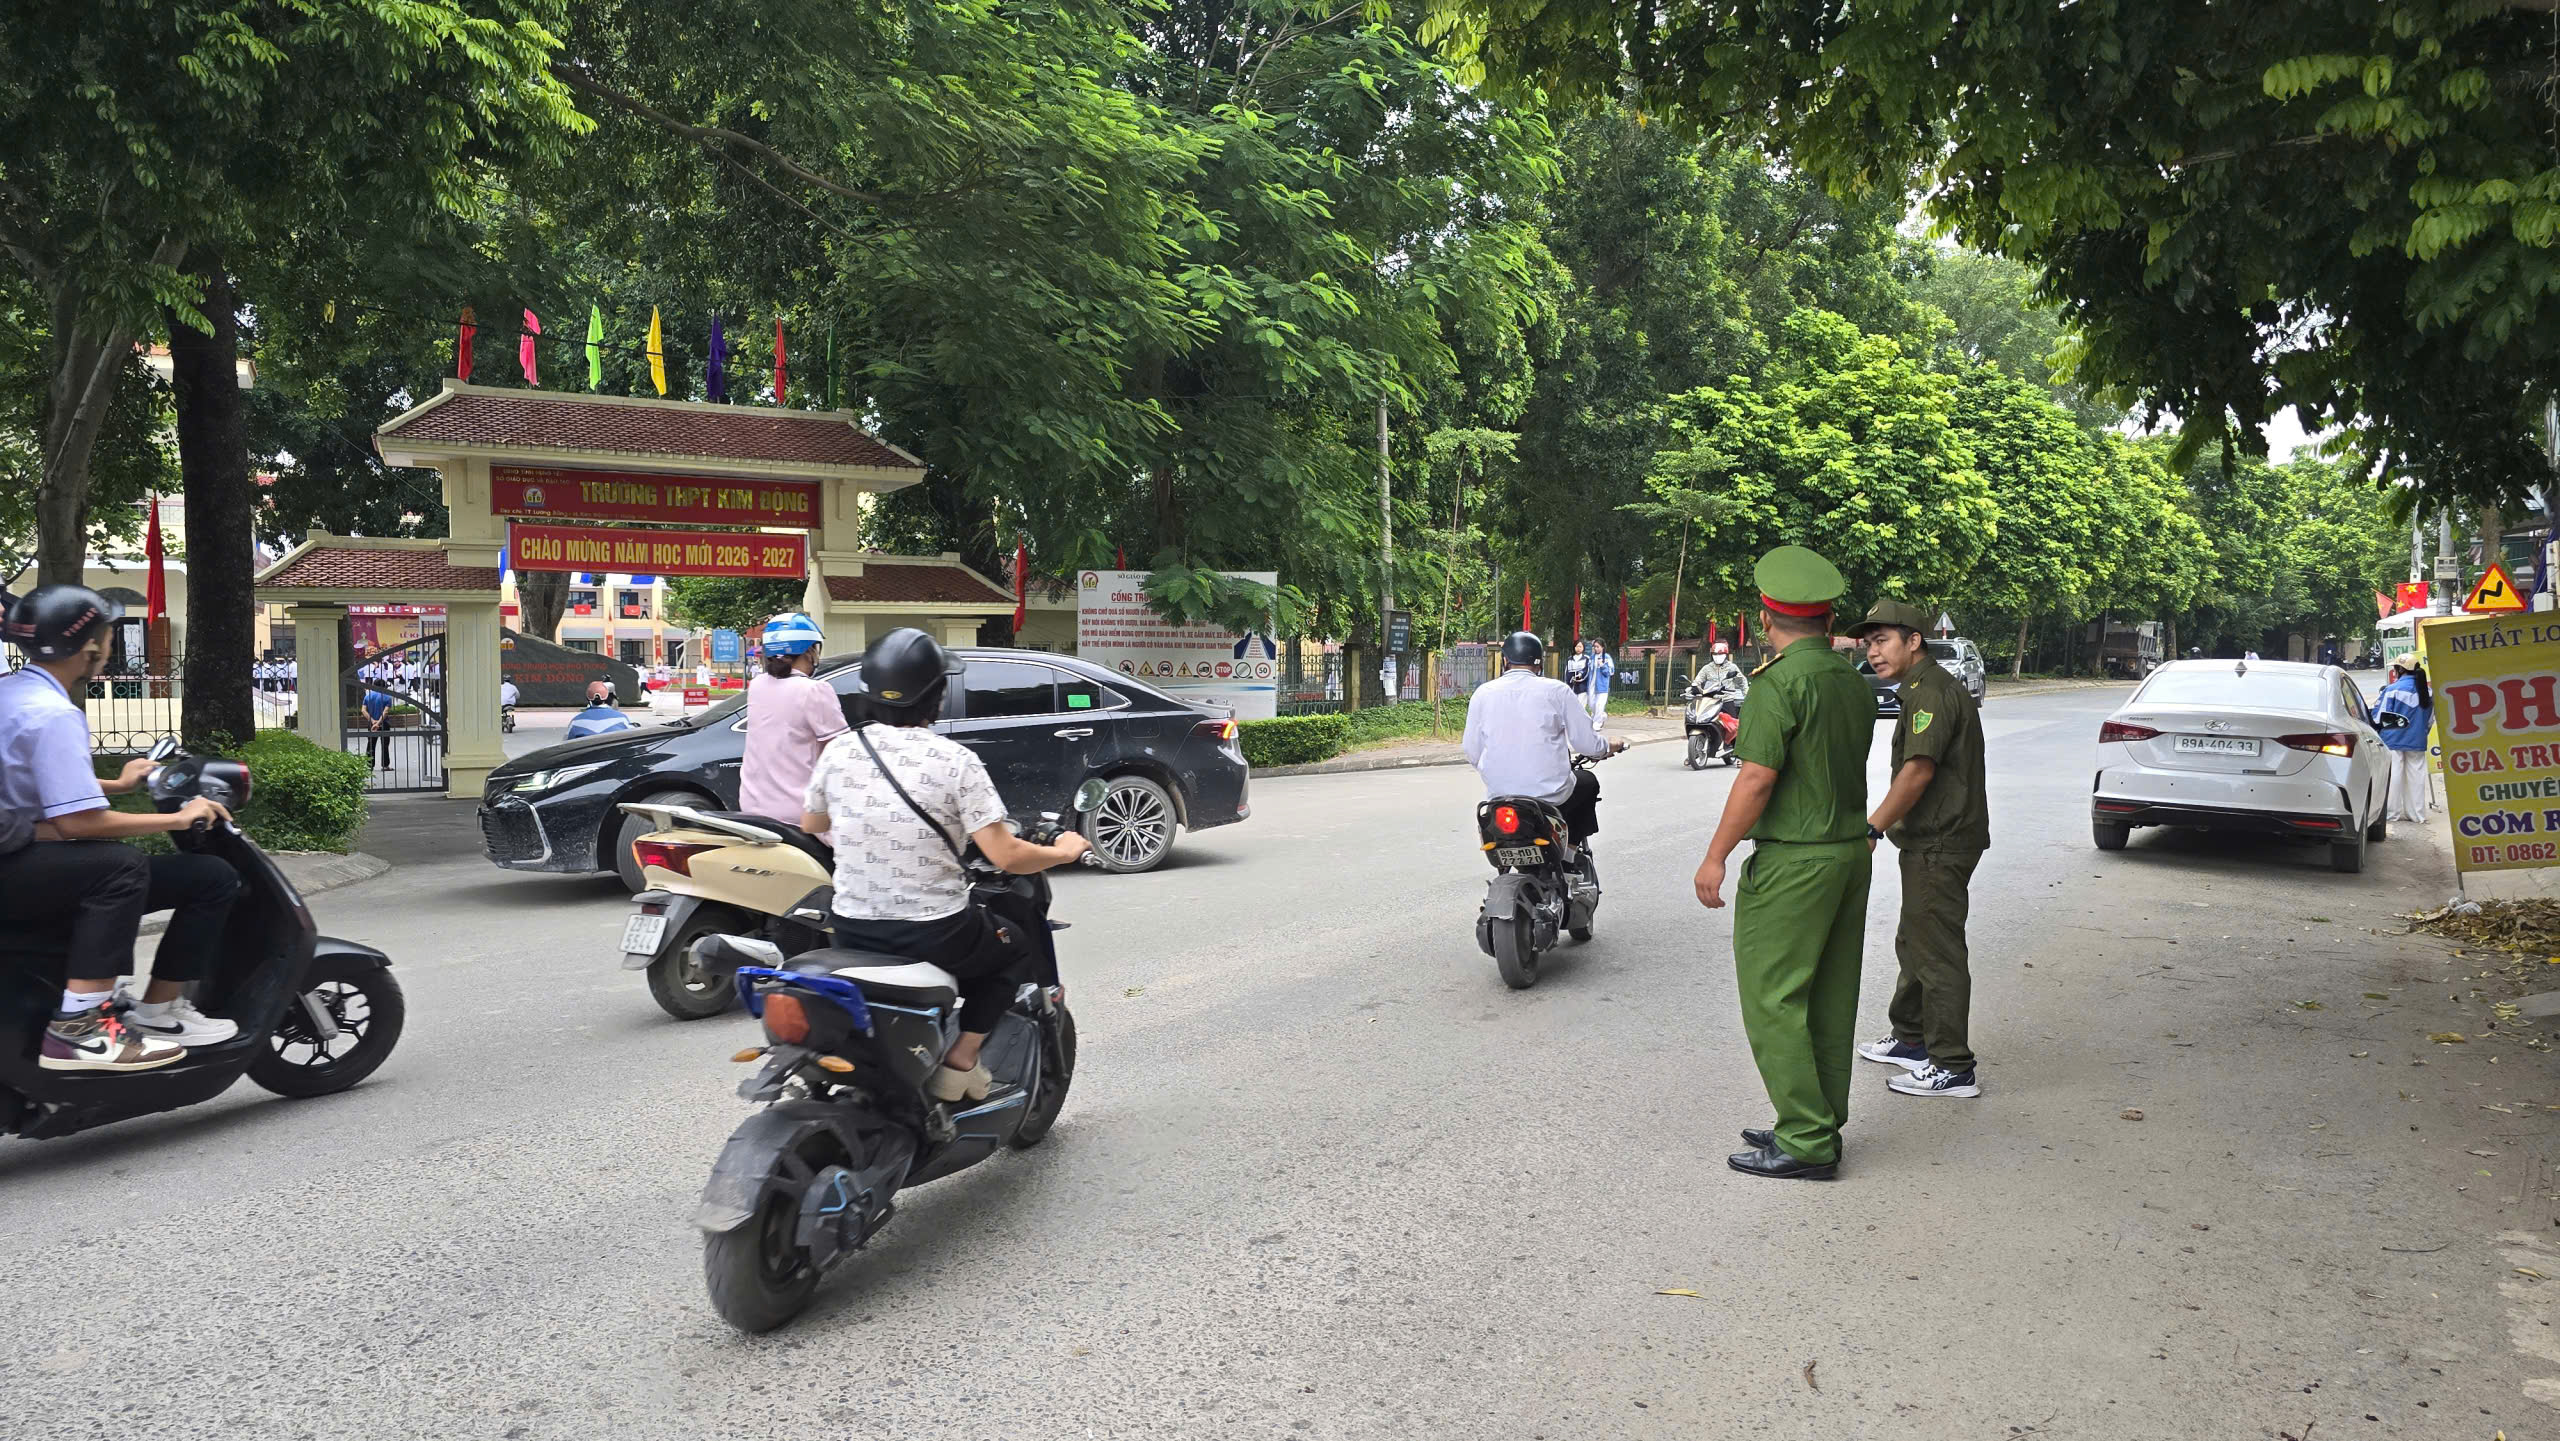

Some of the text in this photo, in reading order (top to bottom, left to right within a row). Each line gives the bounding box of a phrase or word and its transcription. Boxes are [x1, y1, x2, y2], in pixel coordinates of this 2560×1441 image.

[580, 479, 809, 516] TRƯỜNG THPT KIM ĐỘNG
[521, 534, 562, 561] CHÀO
[566, 536, 610, 563] MỪNG
[615, 538, 649, 565] NĂM
[652, 543, 682, 570] HỌC
[685, 538, 713, 567] MỚI
[716, 545, 750, 567] 2026
[762, 546, 795, 568] 2027
[2449, 622, 2560, 653] NHẤT LO
[514, 670, 585, 684] KIM ĐỘNG
[1215, 666, 1232, 674] STOP
[2444, 675, 2560, 735] PH
[2450, 748, 2504, 774] GIA
[2479, 776, 2560, 802] CHUYÊ
[864, 795, 891, 809] Dior
[889, 811, 917, 823] Dior
[2459, 809, 2535, 837] CƠM
[863, 823, 890, 837] Dior
[917, 828, 941, 840] Dio
[840, 834, 863, 847] Dior
[889, 839, 917, 851] Dior
[865, 851, 891, 864] Dior
[2471, 842, 2557, 864] ĐT: 0862
[891, 867, 917, 879] Dior
